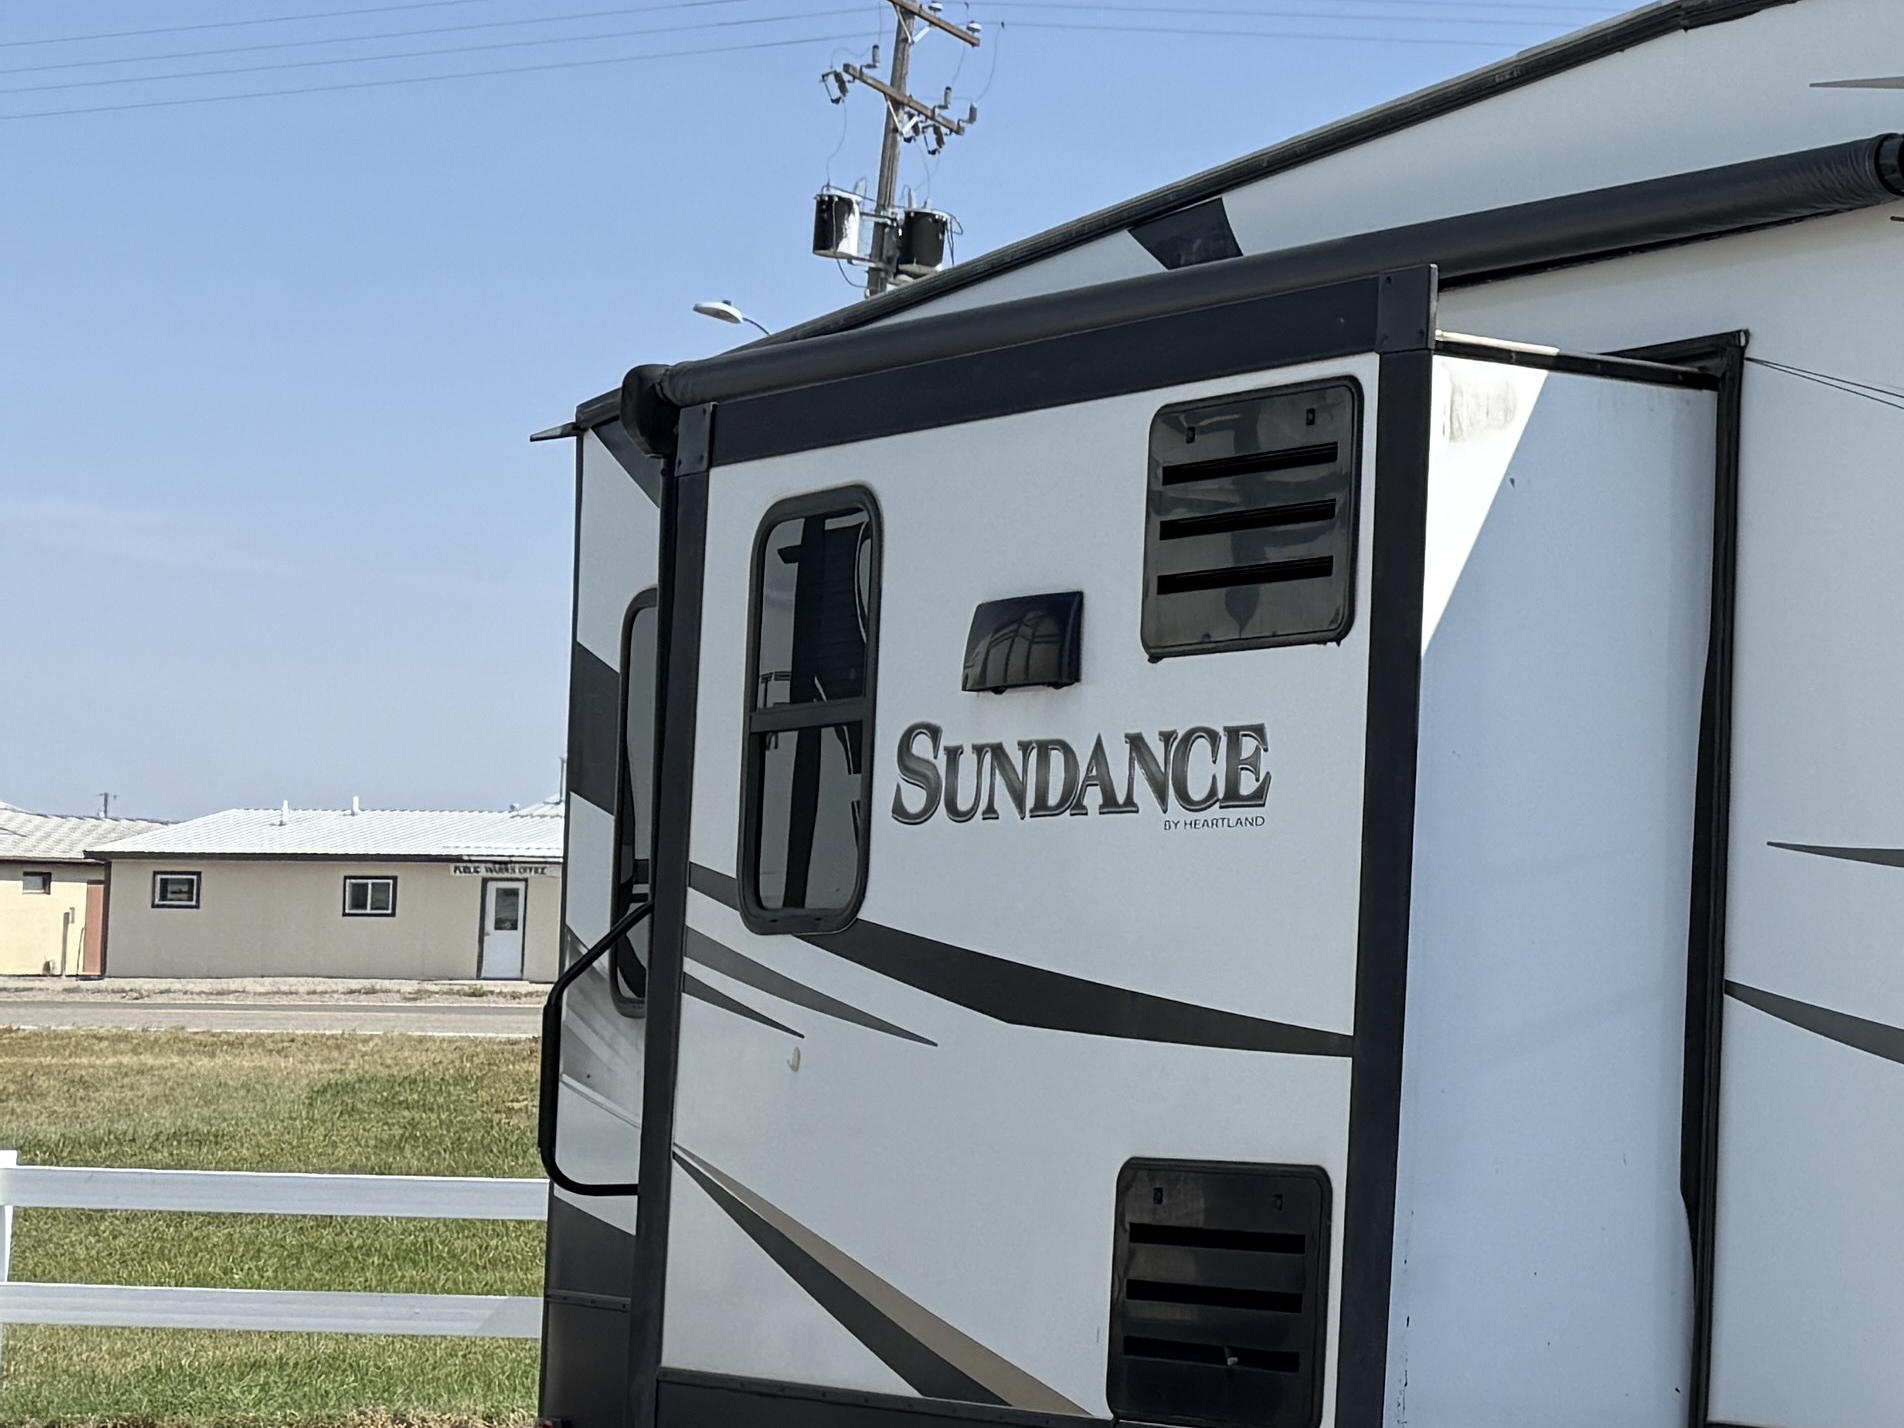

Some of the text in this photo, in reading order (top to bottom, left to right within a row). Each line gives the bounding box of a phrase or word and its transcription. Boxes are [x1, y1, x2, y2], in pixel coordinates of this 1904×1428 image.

[891, 721, 1272, 825] SUNDANCE
[1163, 815, 1266, 831] BY HEARTLAND
